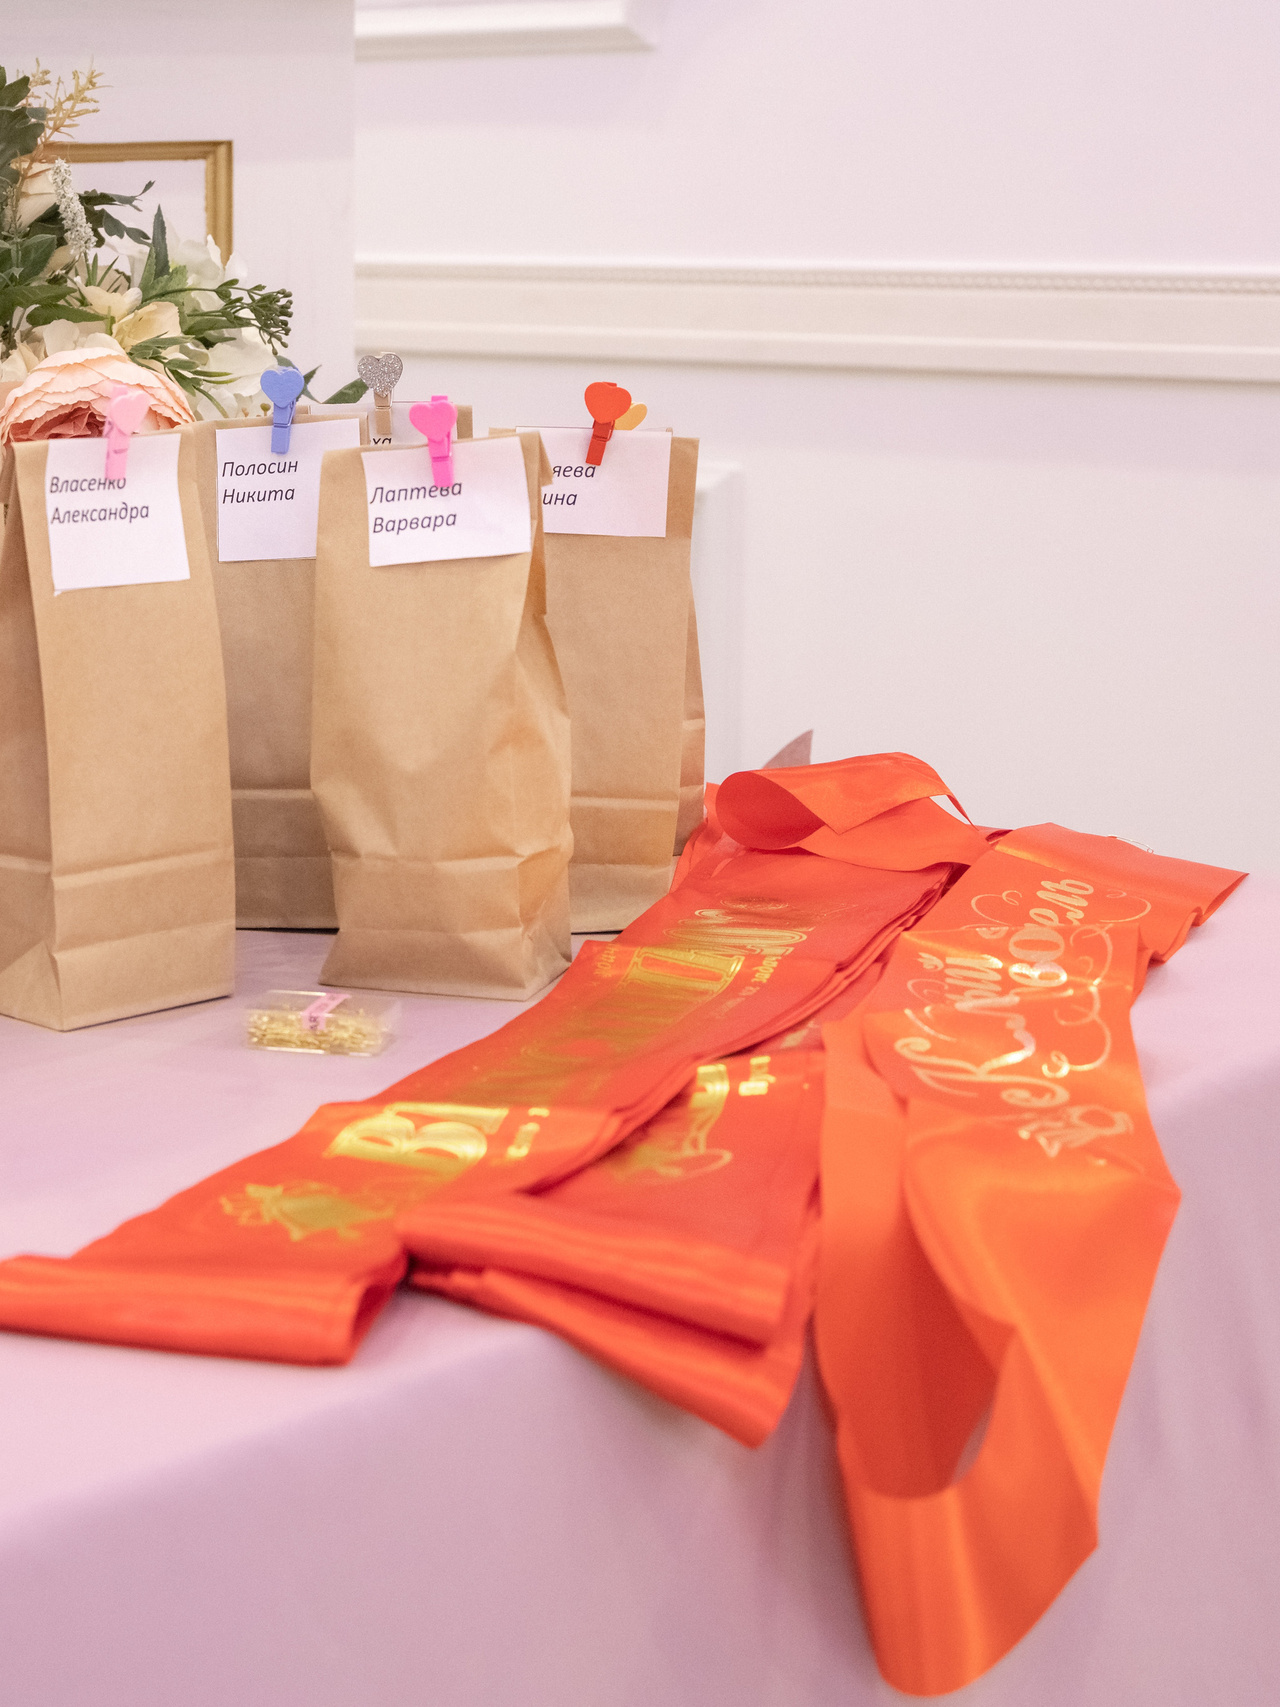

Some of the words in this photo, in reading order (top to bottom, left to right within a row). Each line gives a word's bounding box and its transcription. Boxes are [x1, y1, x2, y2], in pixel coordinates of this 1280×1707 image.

[221, 460, 299, 478] Полосин
[552, 465, 597, 478] яева
[49, 475, 127, 494] Власенко
[369, 482, 463, 505] Лаптева
[222, 487, 296, 504] Никита
[542, 493, 578, 506] ина
[50, 501, 150, 524] Александра
[372, 513, 457, 536] Варвара
